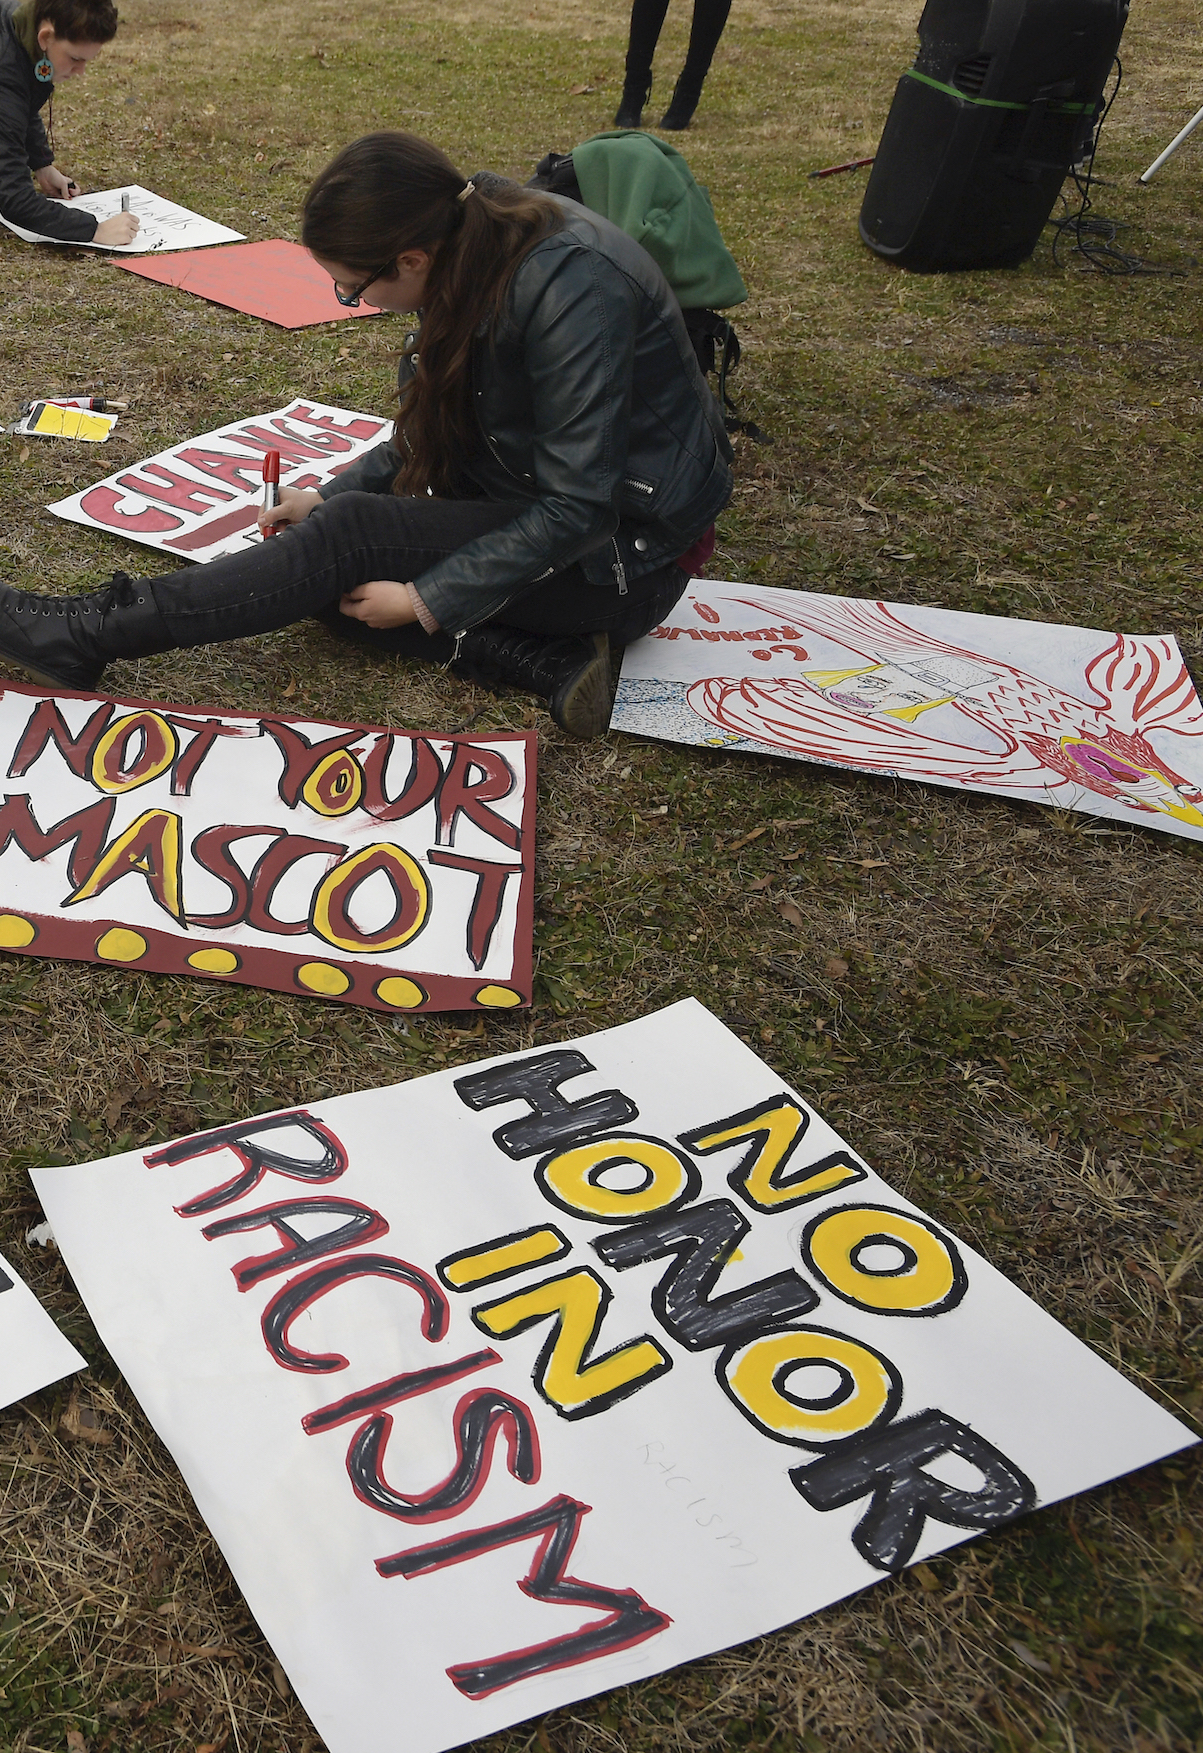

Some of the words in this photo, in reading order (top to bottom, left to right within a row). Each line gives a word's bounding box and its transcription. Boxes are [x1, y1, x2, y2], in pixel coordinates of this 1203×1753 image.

[80, 405, 386, 533] CHANGE
[6, 698, 264, 797] NOT
[259, 718, 526, 851] YOUR
[675, 1092, 969, 1317] NO
[143, 1110, 675, 1699] RACISM
[436, 1223, 674, 1422] IN
[453, 1048, 1038, 1574] HONOR
